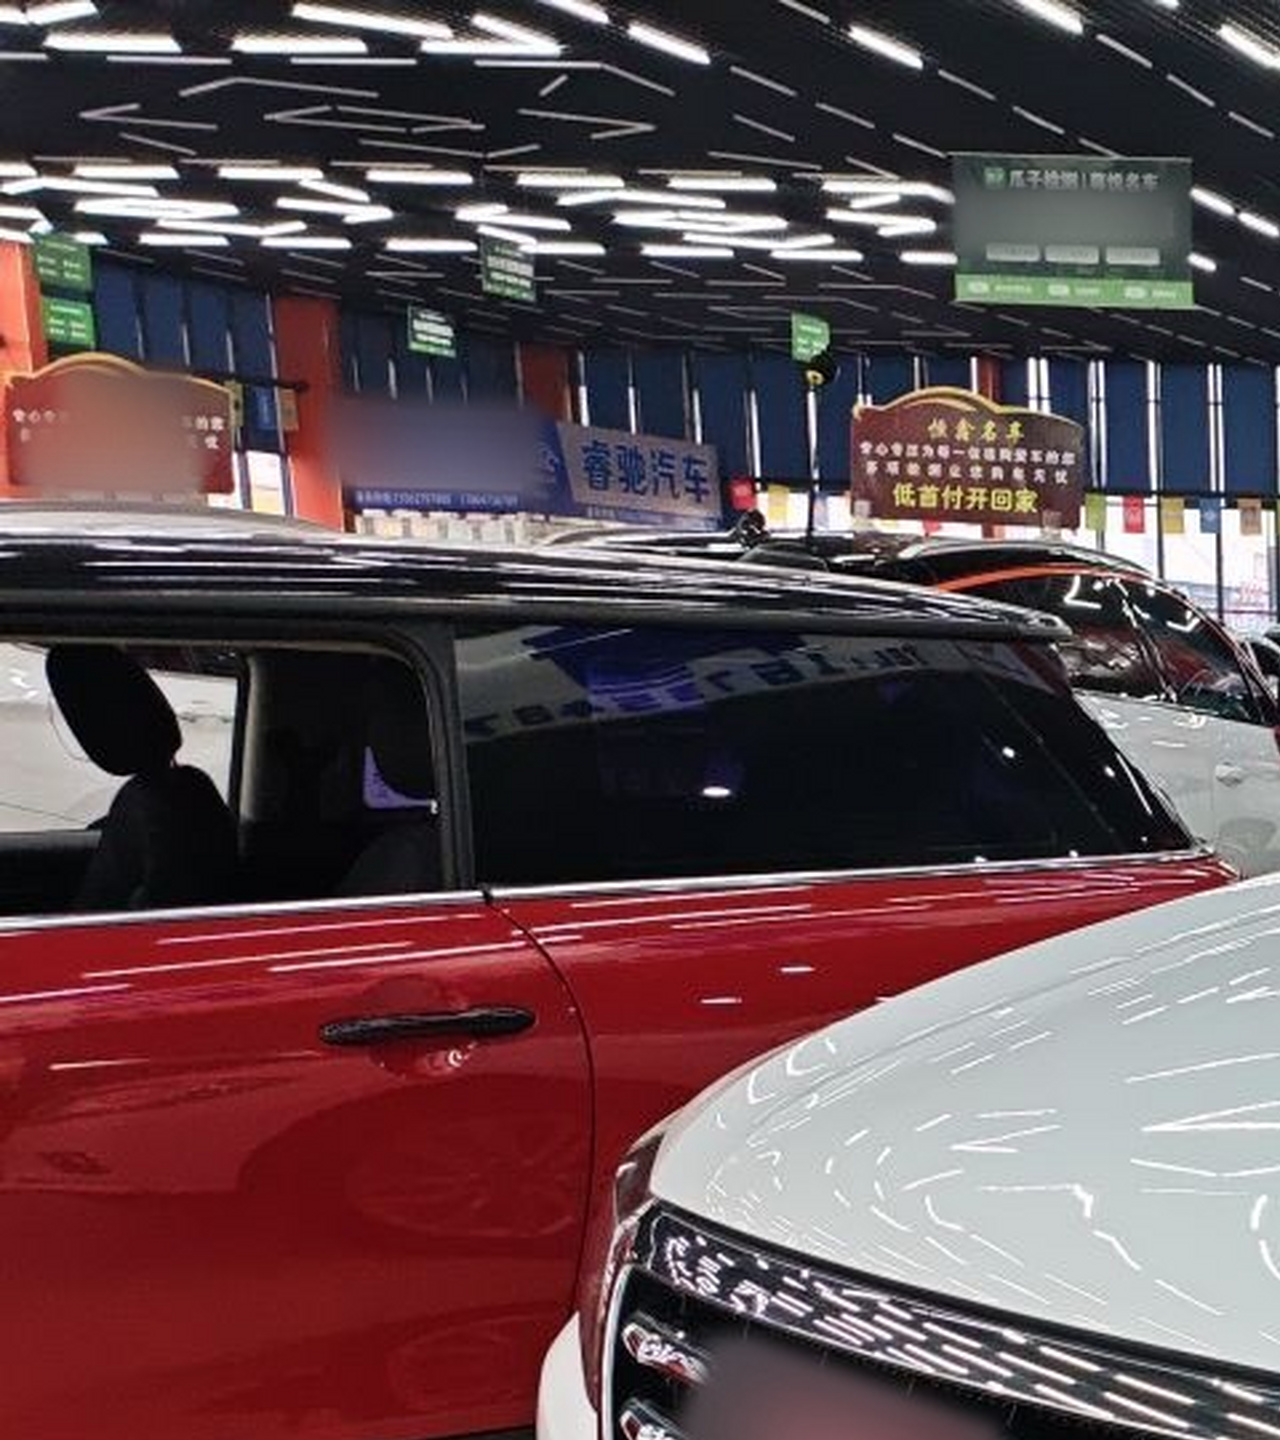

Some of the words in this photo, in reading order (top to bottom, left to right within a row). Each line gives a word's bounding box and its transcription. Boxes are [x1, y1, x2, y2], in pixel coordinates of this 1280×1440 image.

[582, 440, 710, 503] 睿驰汽车
[892, 483, 1038, 513] 低首付开回家
